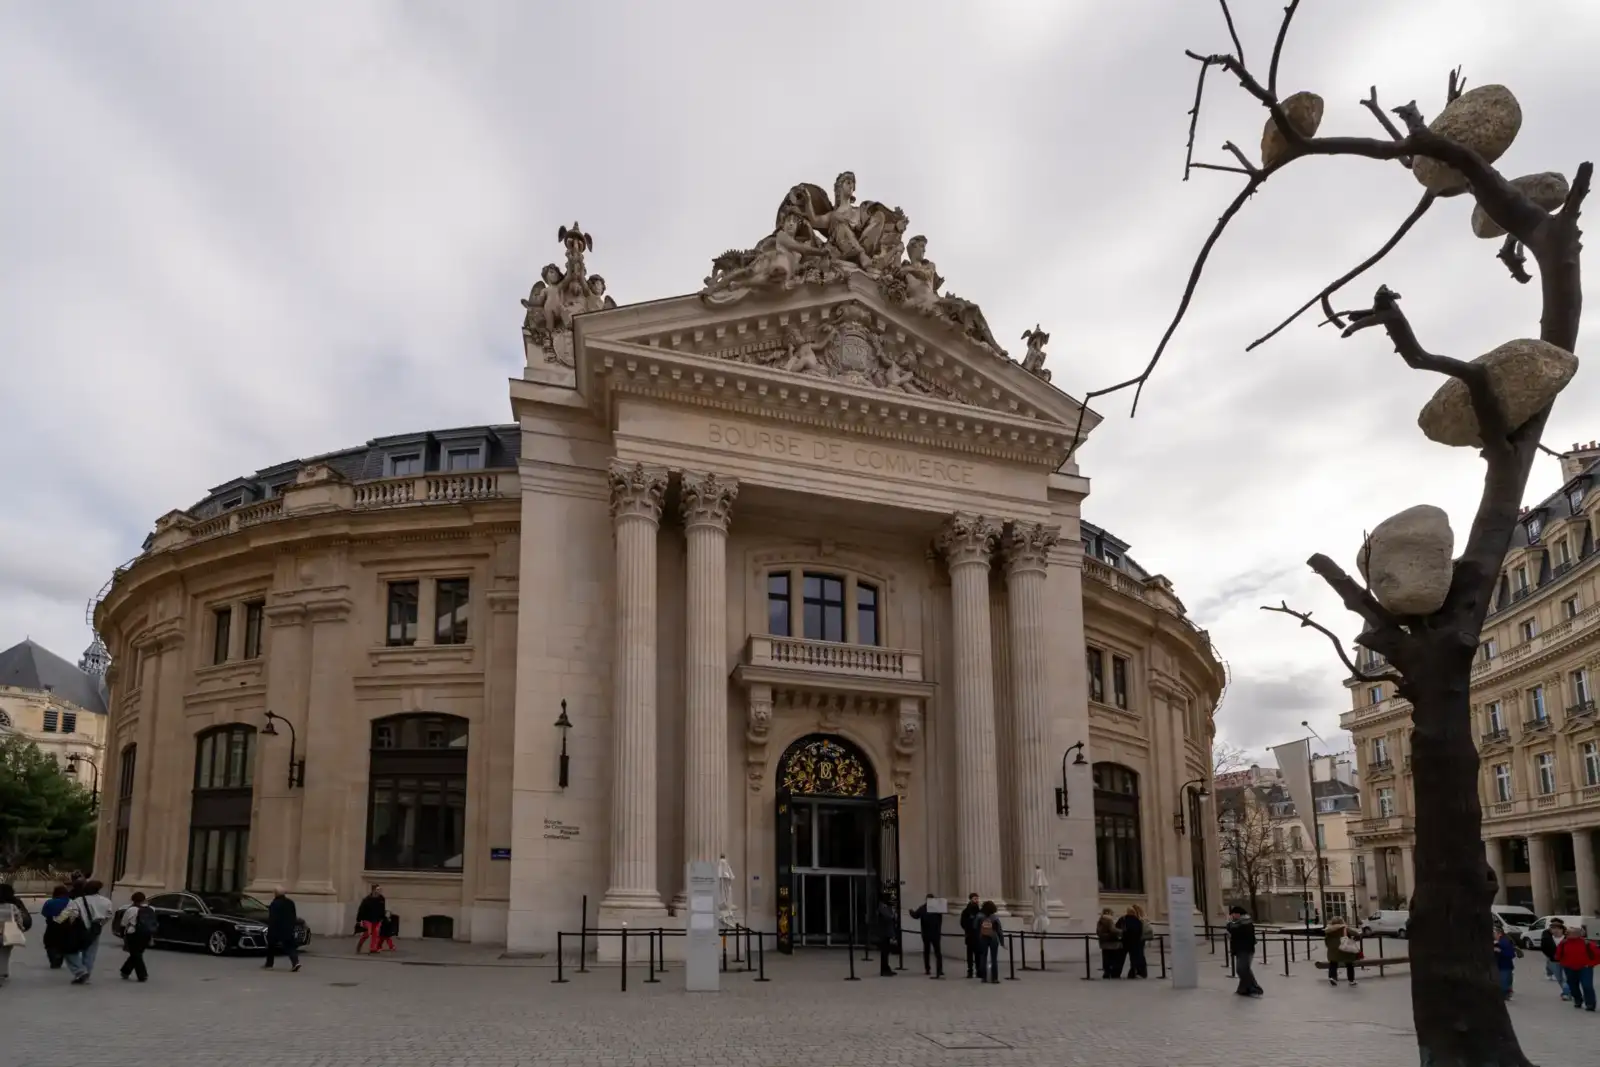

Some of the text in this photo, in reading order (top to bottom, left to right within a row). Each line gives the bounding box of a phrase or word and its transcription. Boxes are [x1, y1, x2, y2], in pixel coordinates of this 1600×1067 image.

[708, 423, 976, 485] BOURSE DE COMMERCE
